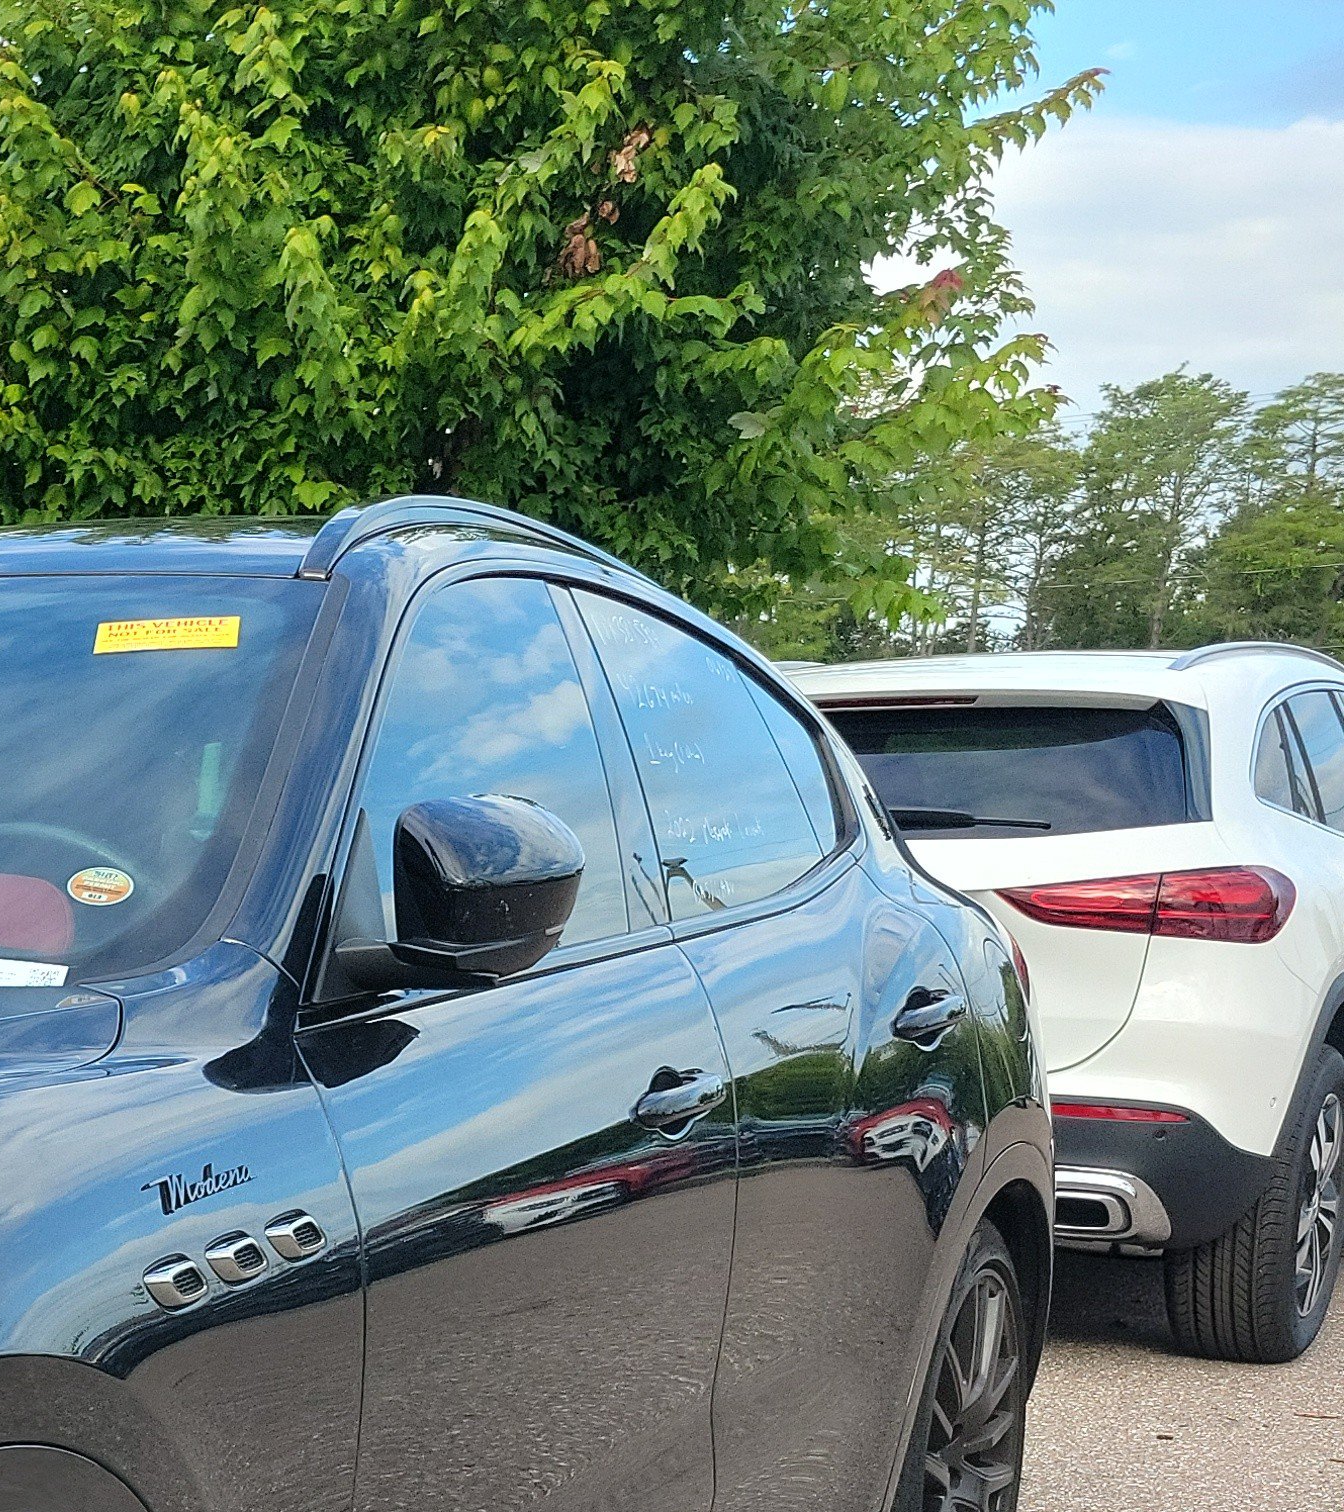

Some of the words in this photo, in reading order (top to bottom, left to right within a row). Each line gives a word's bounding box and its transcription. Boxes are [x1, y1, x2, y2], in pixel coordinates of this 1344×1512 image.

[108, 622, 146, 632] THIS
[152, 619, 229, 629] VEHICLE
[141, 1162, 258, 1215] Modena
